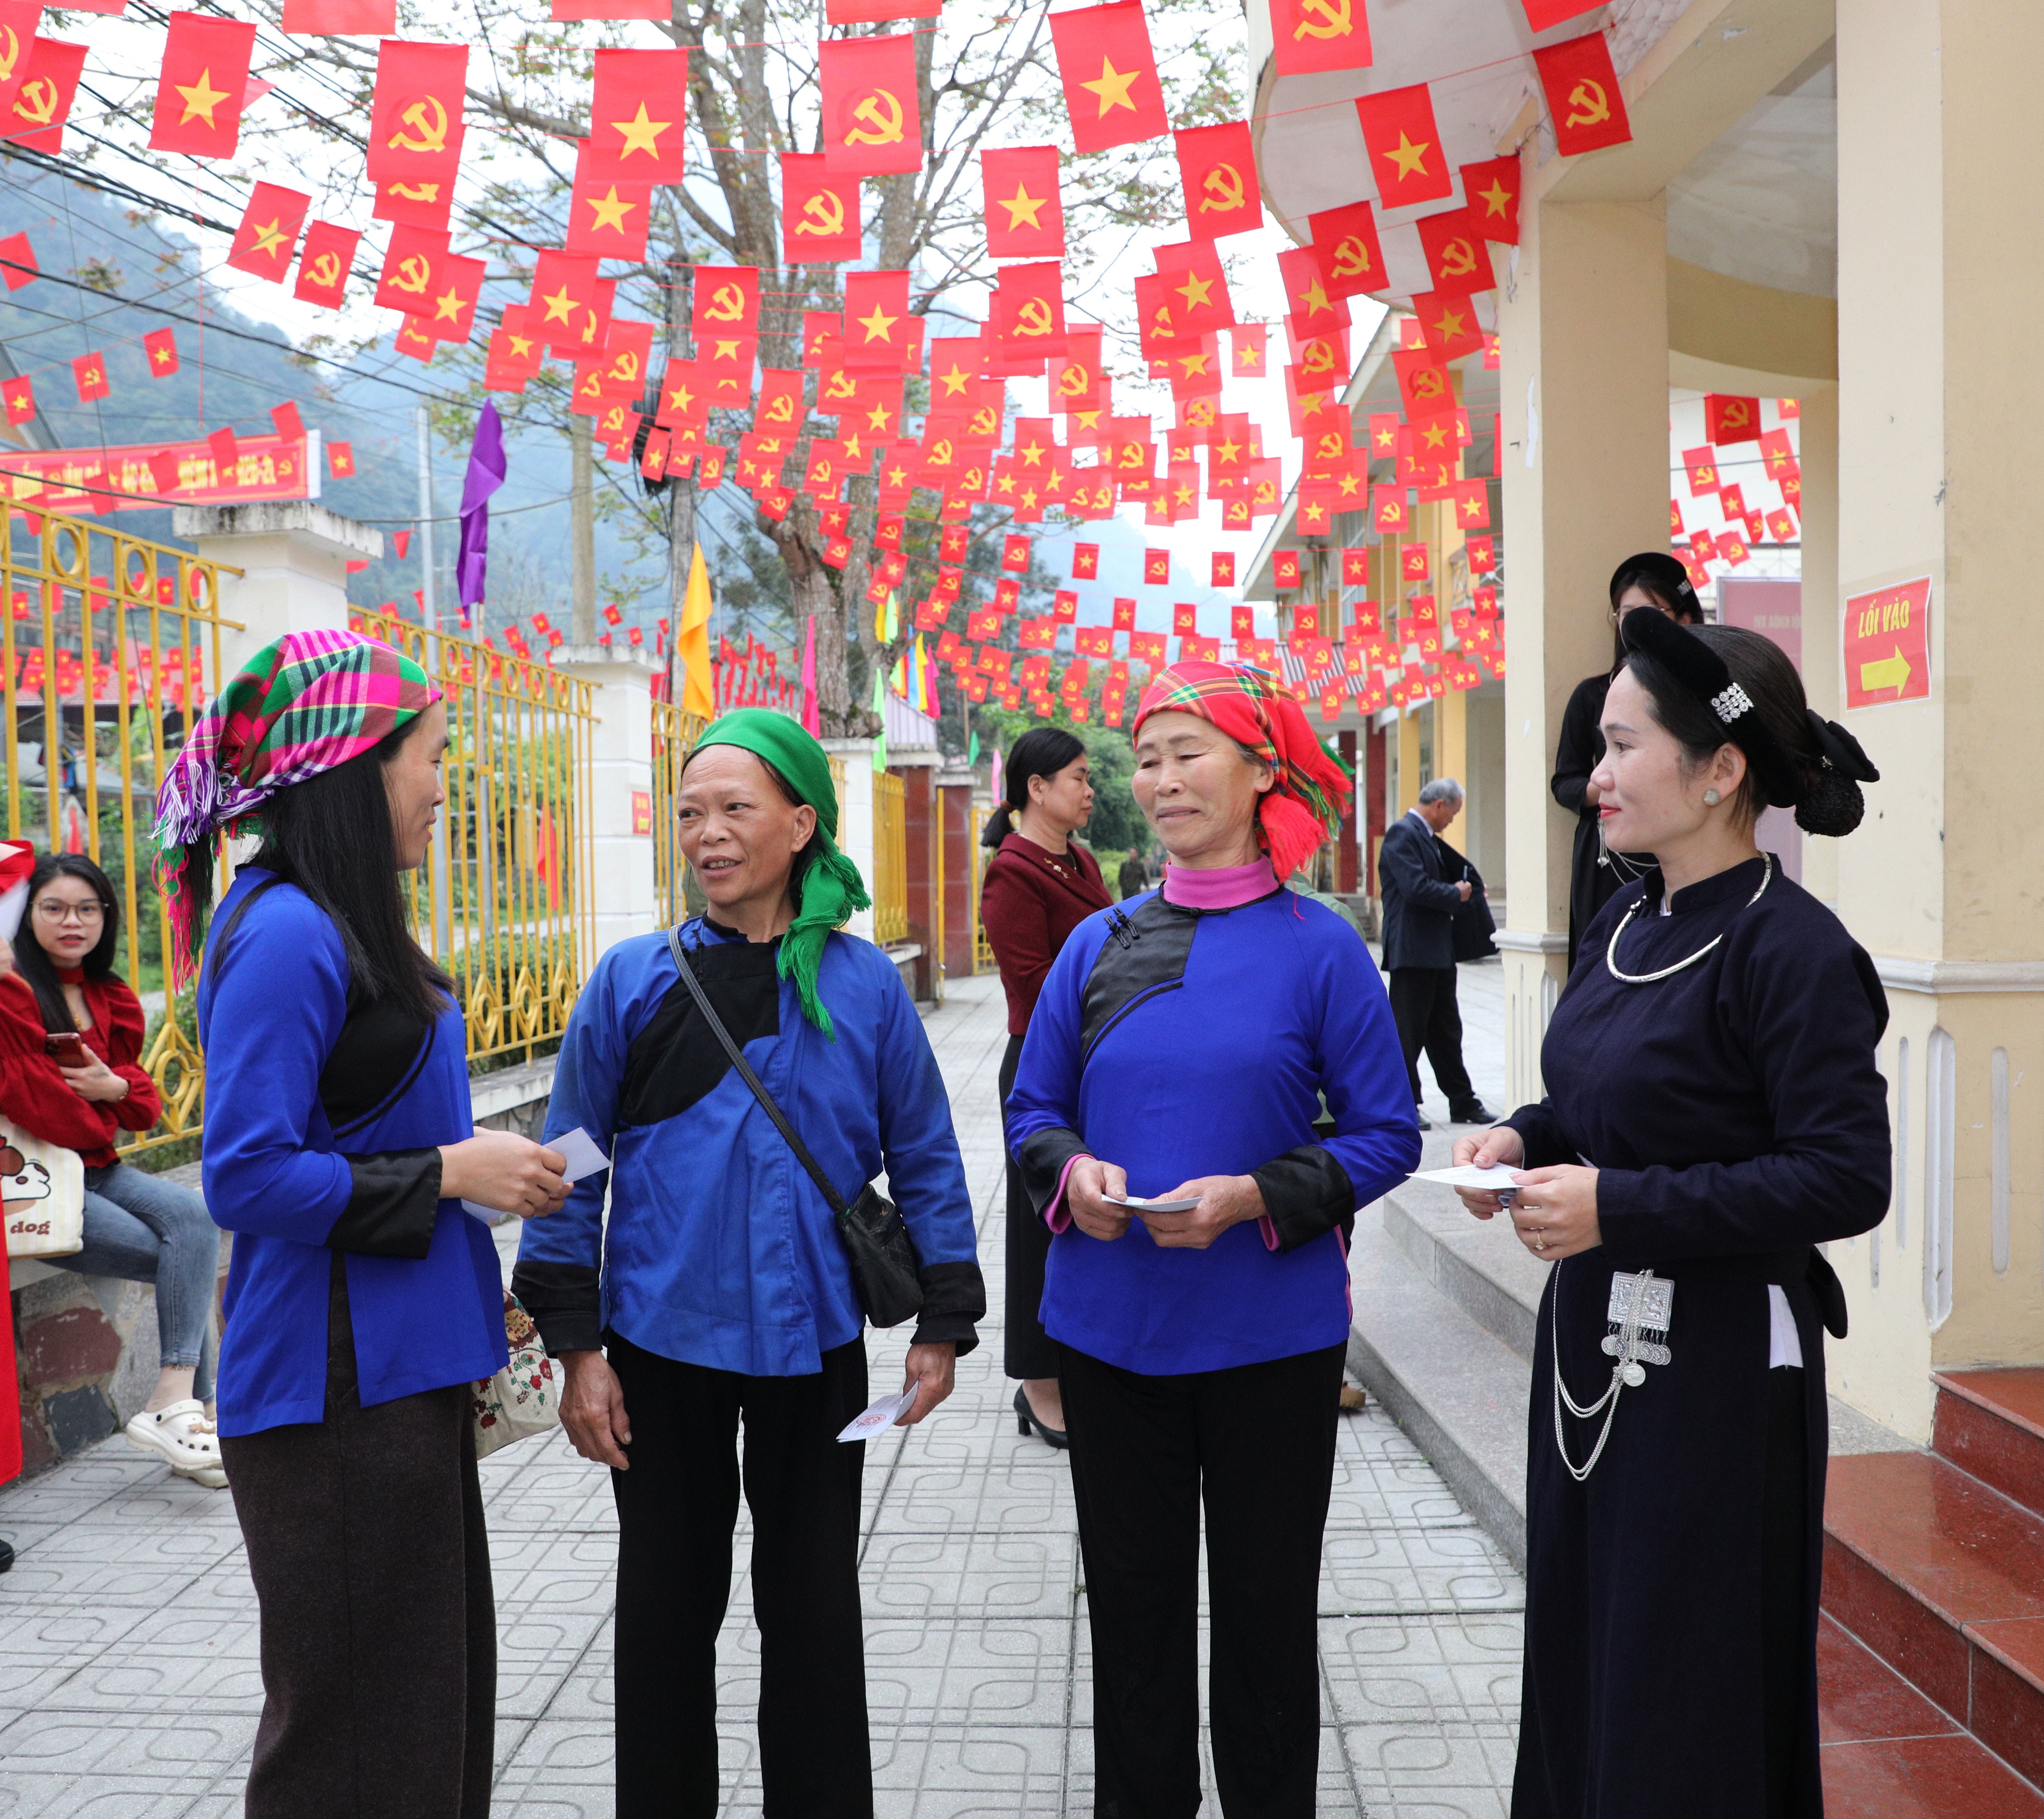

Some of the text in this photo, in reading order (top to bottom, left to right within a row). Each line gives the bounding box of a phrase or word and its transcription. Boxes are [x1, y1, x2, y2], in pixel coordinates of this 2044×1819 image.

[1858, 596, 1910, 638] LỐI VÀO
[10, 1221, 51, 1235] dog
